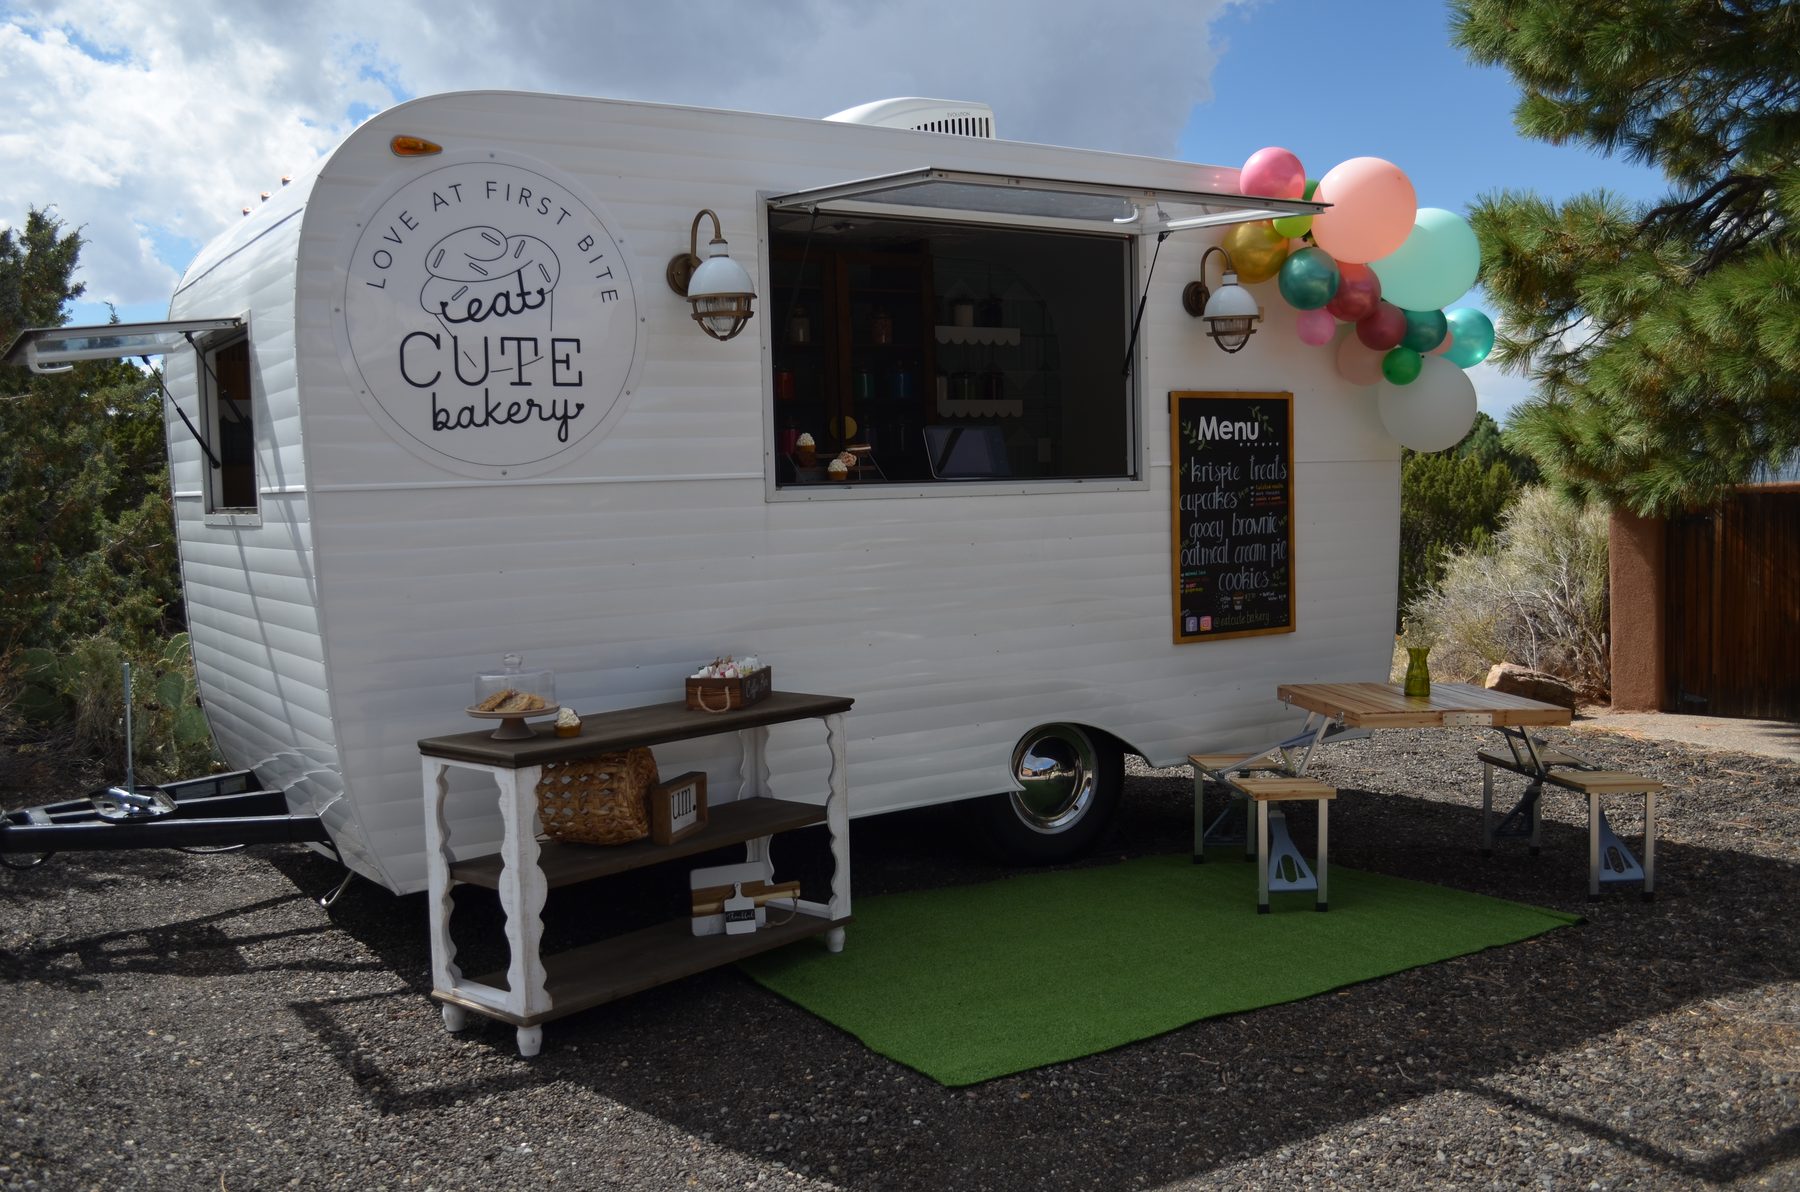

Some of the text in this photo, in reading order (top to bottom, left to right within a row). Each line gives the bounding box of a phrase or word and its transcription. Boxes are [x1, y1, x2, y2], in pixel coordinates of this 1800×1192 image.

[366, 181, 619, 303] LOVE AT FIRST BITE
[440, 269, 546, 323] eat
[399, 331, 583, 388] CUTE
[431, 387, 584, 443] bakery
[1198, 415, 1260, 441] Menu
[1191, 456, 1241, 488] krispie
[1249, 454, 1288, 480] treats
[1179, 485, 1238, 518] cupcakes
[1189, 519, 1224, 544] gooey
[1232, 511, 1278, 536] brownie
[1180, 537, 1287, 568] oatmeal cream pie
[1218, 565, 1269, 591] cookies
